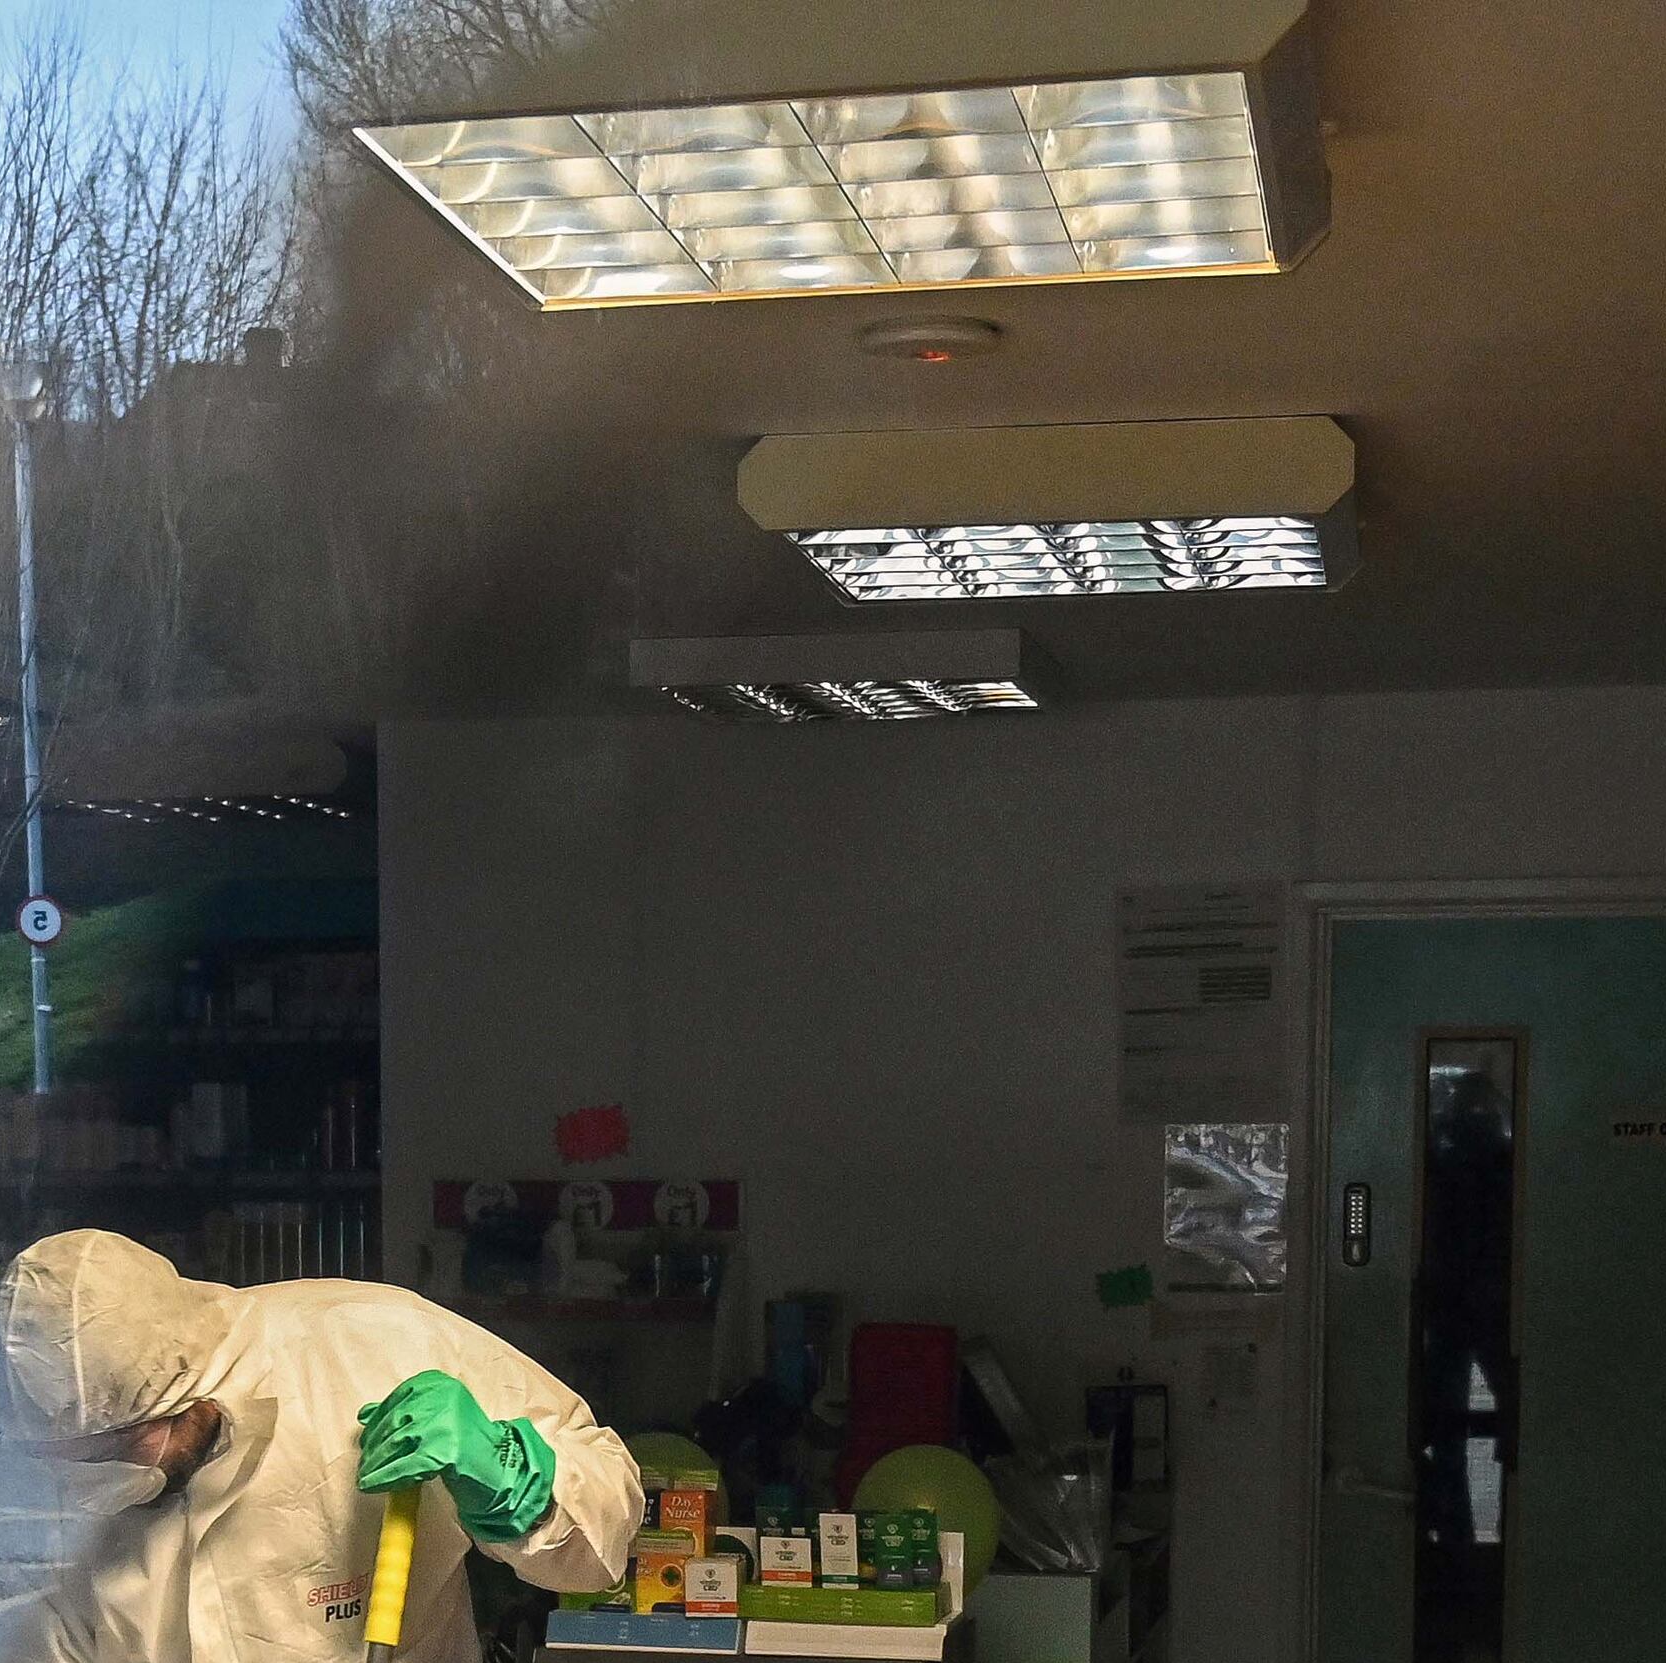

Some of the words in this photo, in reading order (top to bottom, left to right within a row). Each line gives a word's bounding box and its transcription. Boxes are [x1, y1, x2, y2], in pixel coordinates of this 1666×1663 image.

[1613, 1122, 1655, 1136] STAFF
[671, 1496, 693, 1508] Day
[665, 1506, 701, 1519] Nurse
[325, 1598, 362, 1624] PLUS
